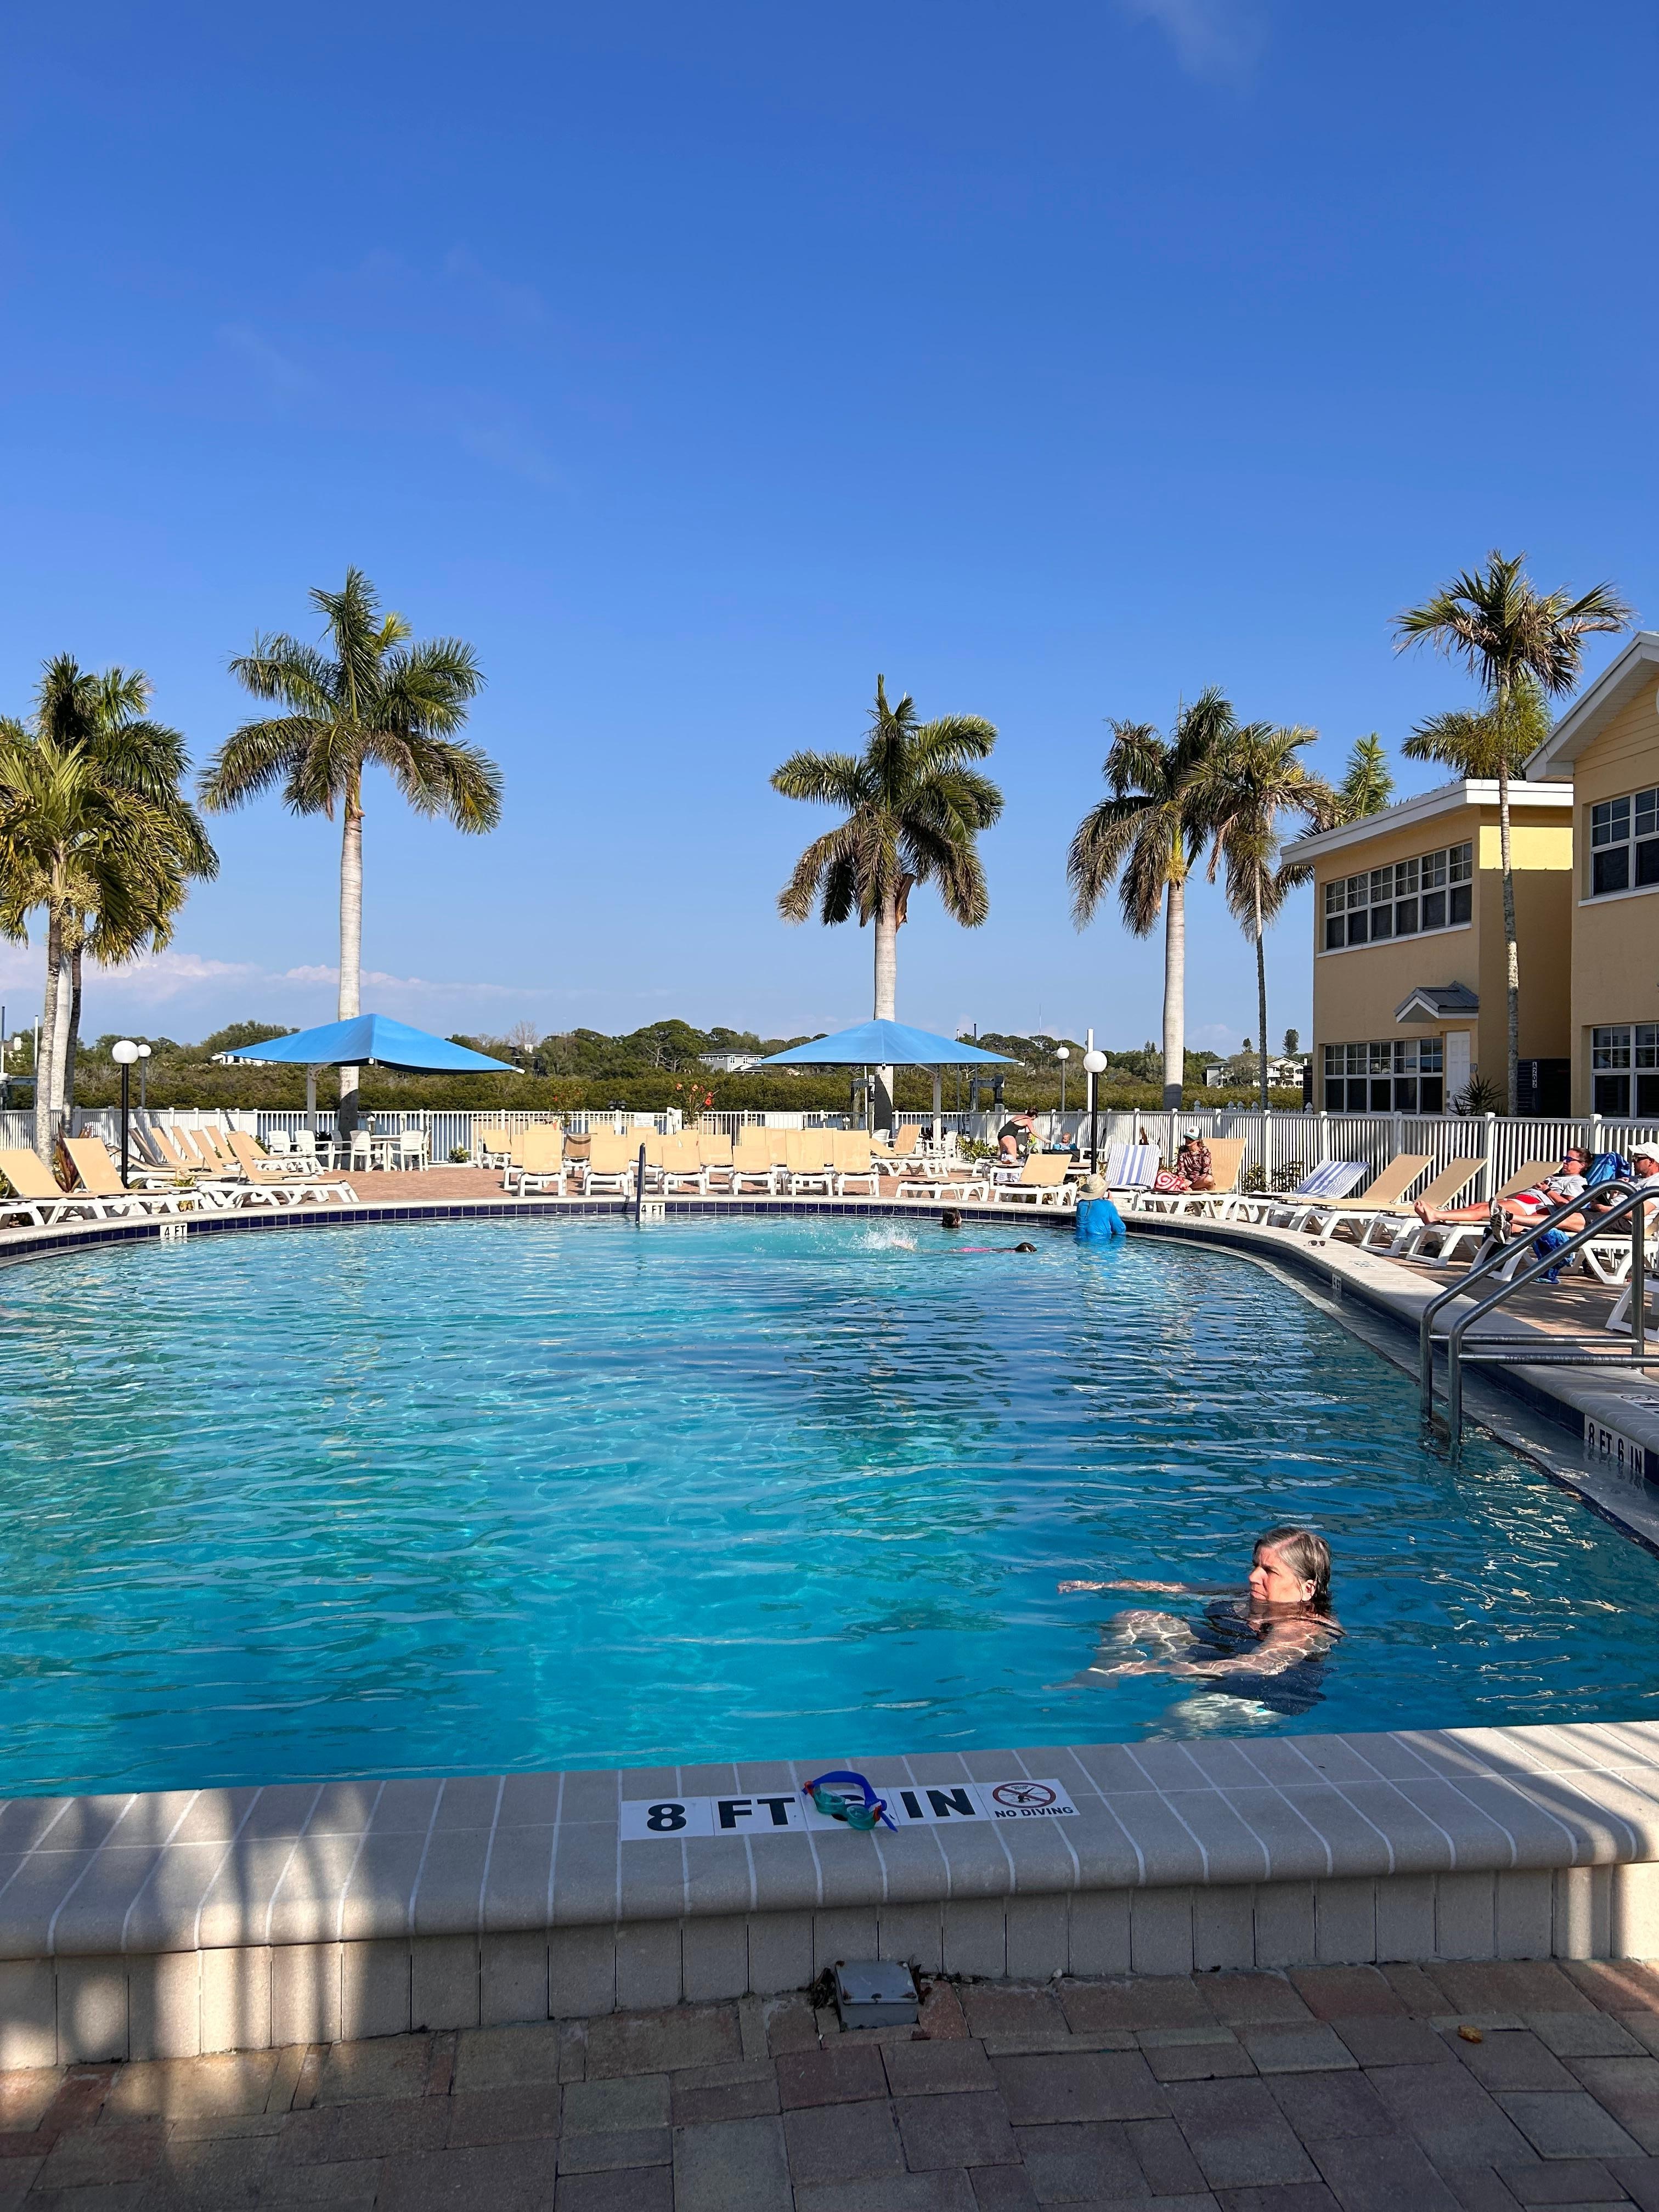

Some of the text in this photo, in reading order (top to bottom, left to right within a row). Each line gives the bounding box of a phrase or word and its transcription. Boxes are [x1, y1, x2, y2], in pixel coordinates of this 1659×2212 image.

[641, 1204, 663, 1215] 4 FT
[164, 1225, 185, 1236] 4 FT
[1588, 1422, 1643, 1474] 8 FT 6 IN
[647, 1803, 686, 1831] 8
[718, 1797, 795, 1829] FT
[900, 1788, 976, 1819] IN
[1020, 1807, 1074, 1816] DIVING
